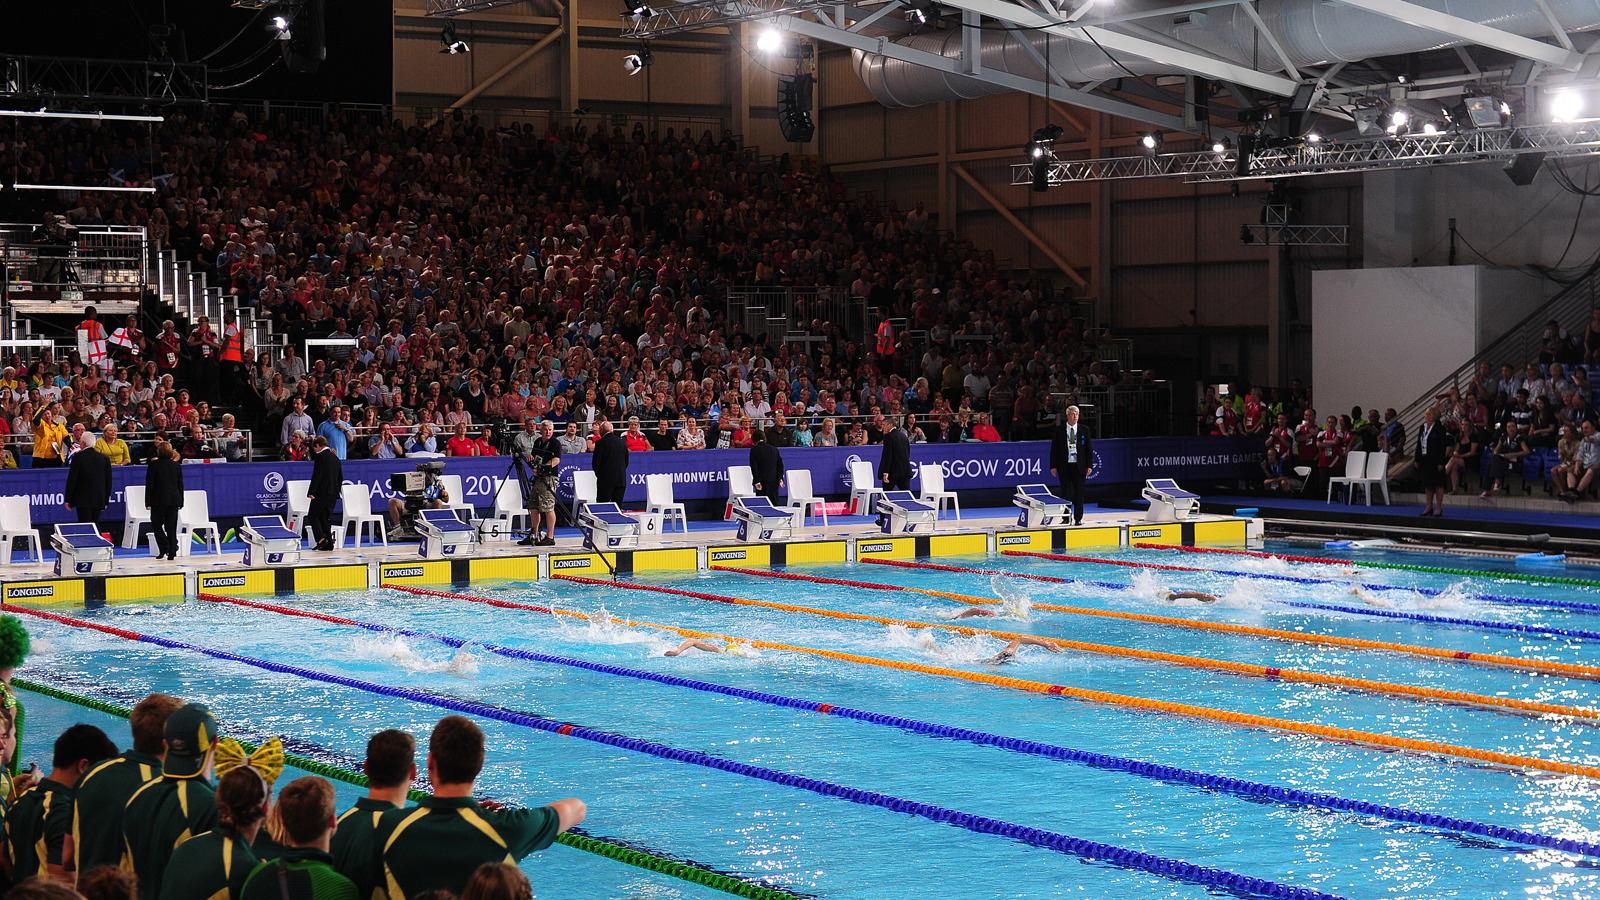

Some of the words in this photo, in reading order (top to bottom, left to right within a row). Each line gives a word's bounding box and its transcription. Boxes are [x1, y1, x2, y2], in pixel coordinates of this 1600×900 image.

[1137, 457, 1150, 467] XX
[1153, 454, 1229, 466] COMMONWEALTH
[1232, 453, 1263, 464] GAMES
[910, 459, 999, 479] GSGOW
[1005, 458, 1042, 477] 2014
[630, 474, 646, 485] XX
[647, 518, 654, 531] 6
[491, 524, 499, 538] 5
[739, 524, 745, 536] 6
[1132, 529, 1161, 538] LONGINES
[1000, 537, 1030, 545] LONGINES
[860, 543, 893, 552] LONGINES
[271, 553, 280, 562] 3
[712, 551, 746, 560] LONGINES
[80, 562, 89, 571] 2
[554, 559, 590, 568] LONGINES
[384, 568, 423, 577] LONGINES
[203, 577, 245, 587] LONGINES
[7, 587, 53, 597] LONGINES
